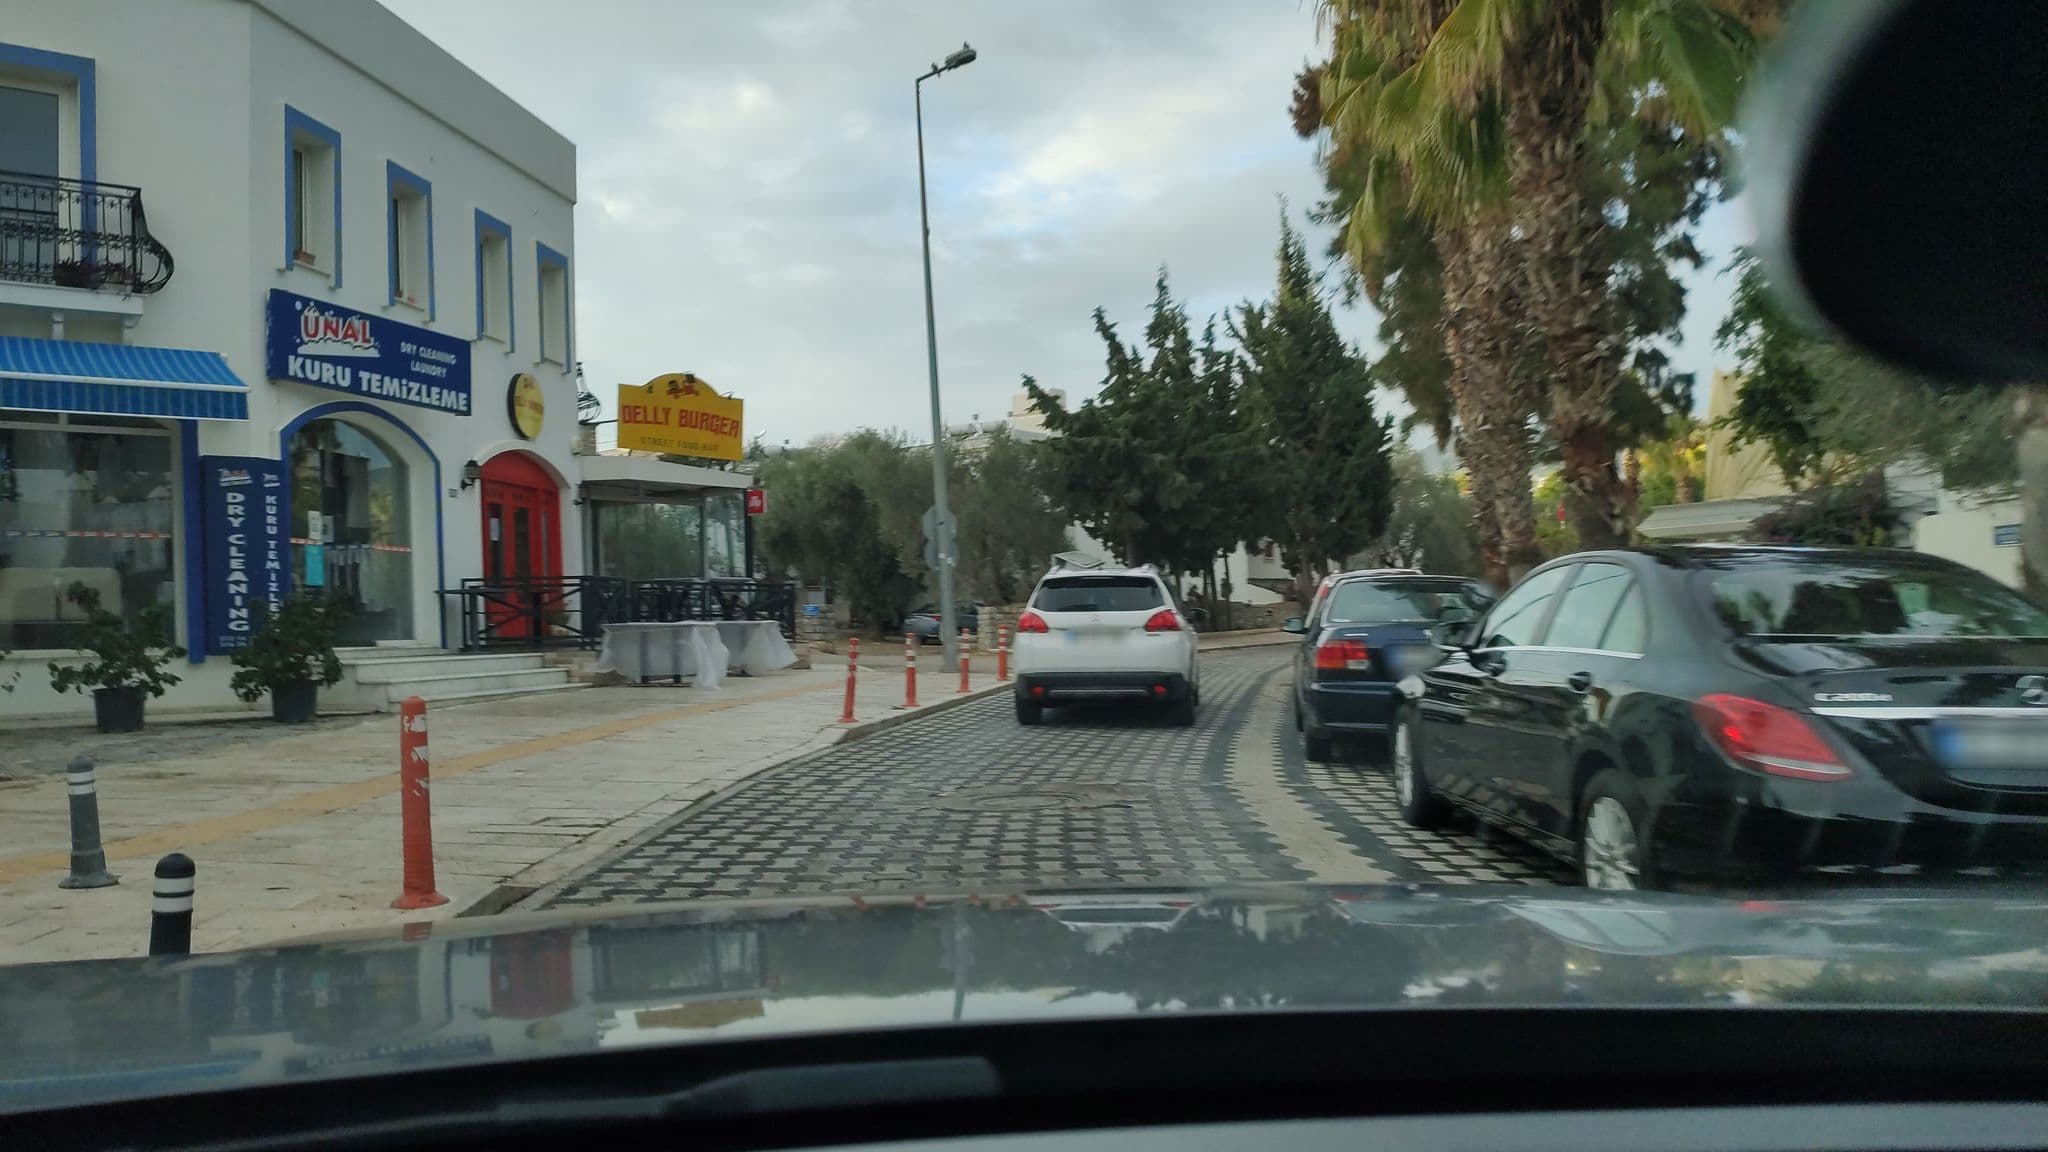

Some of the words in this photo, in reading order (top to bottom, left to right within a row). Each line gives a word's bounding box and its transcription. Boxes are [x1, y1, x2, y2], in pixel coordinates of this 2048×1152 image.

[400, 341, 417, 355] DRY
[419, 346, 456, 365] CLEANING
[411, 359, 447, 379] LAUNDRY
[288, 355, 351, 387] KURU
[621, 404, 672, 426] DELLY
[678, 408, 740, 438] BURGER
[226, 492, 246, 528] DRY
[265, 495, 278, 535] KURU
[226, 533, 250, 631] CLEANING
